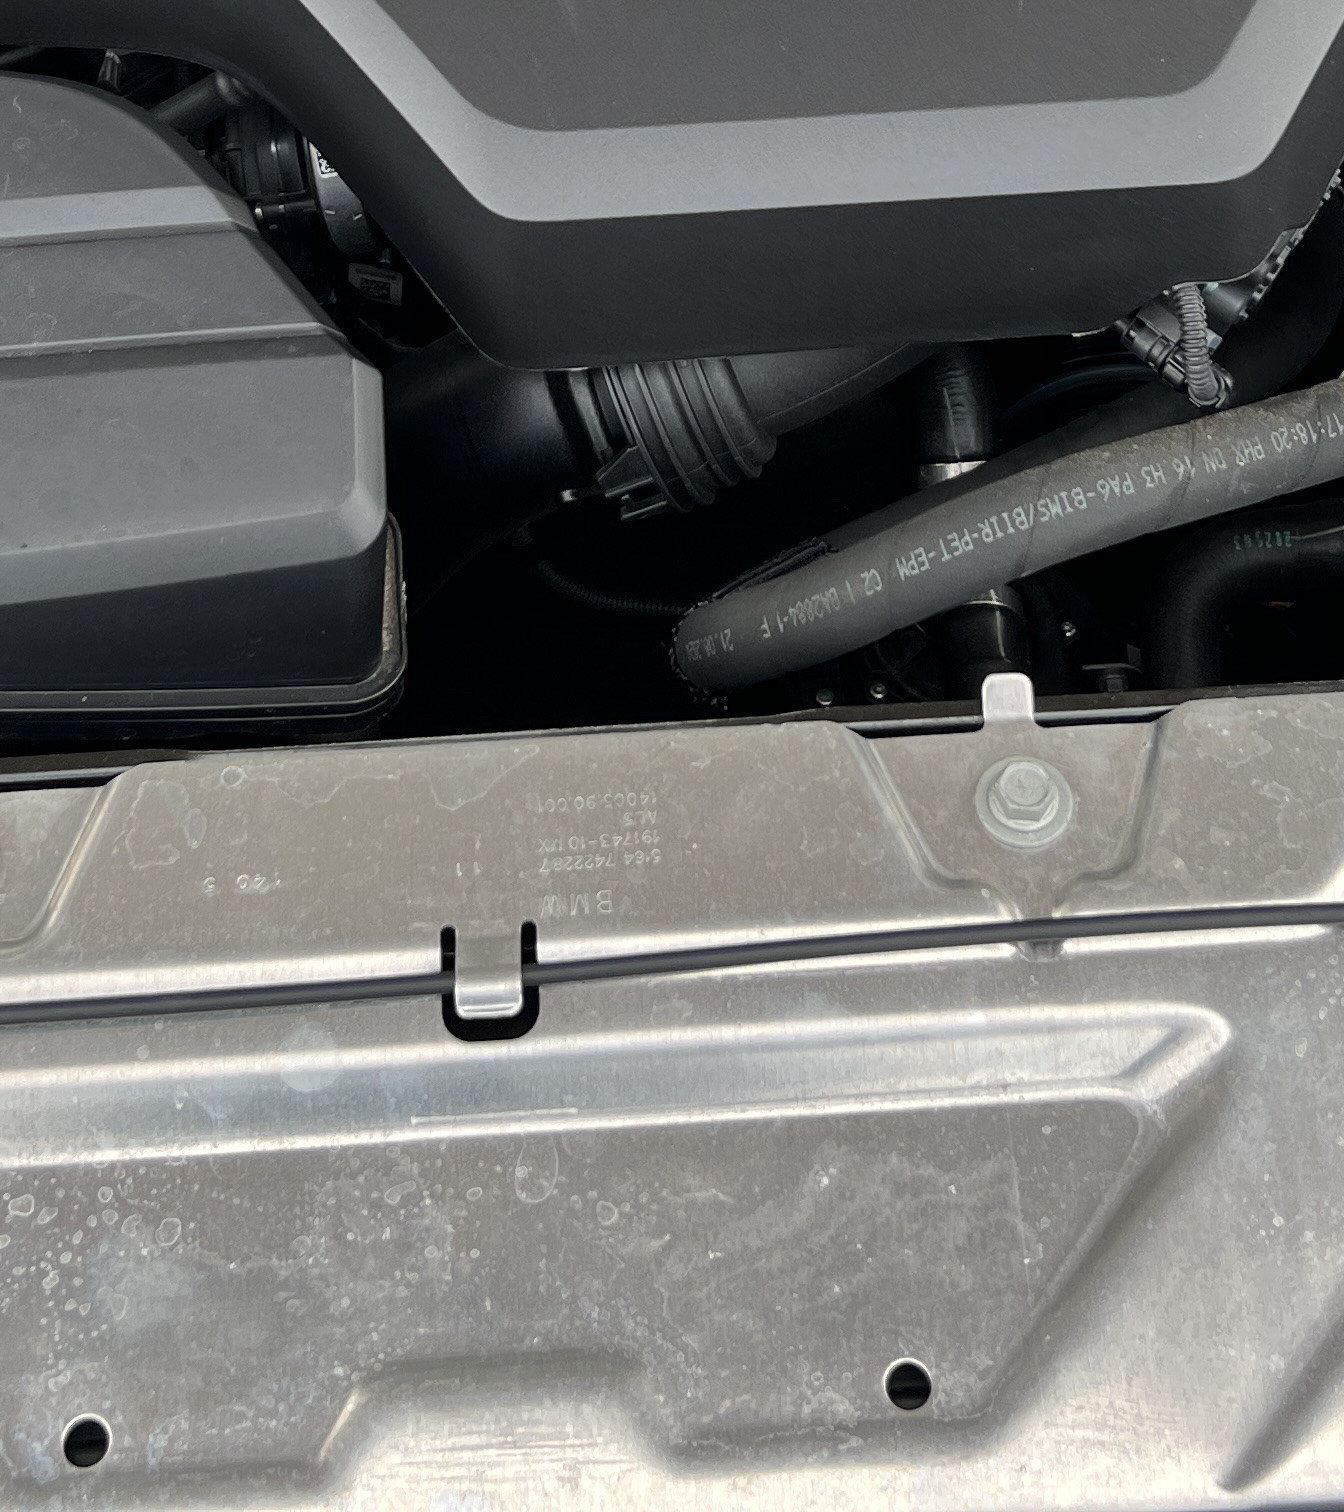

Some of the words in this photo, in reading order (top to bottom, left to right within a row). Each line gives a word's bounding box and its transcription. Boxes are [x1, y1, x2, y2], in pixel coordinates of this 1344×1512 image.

[1270, 413, 1344, 454] 17:18:20
[1141, 465, 1166, 489] H3
[540, 889, 613, 917] BMW
